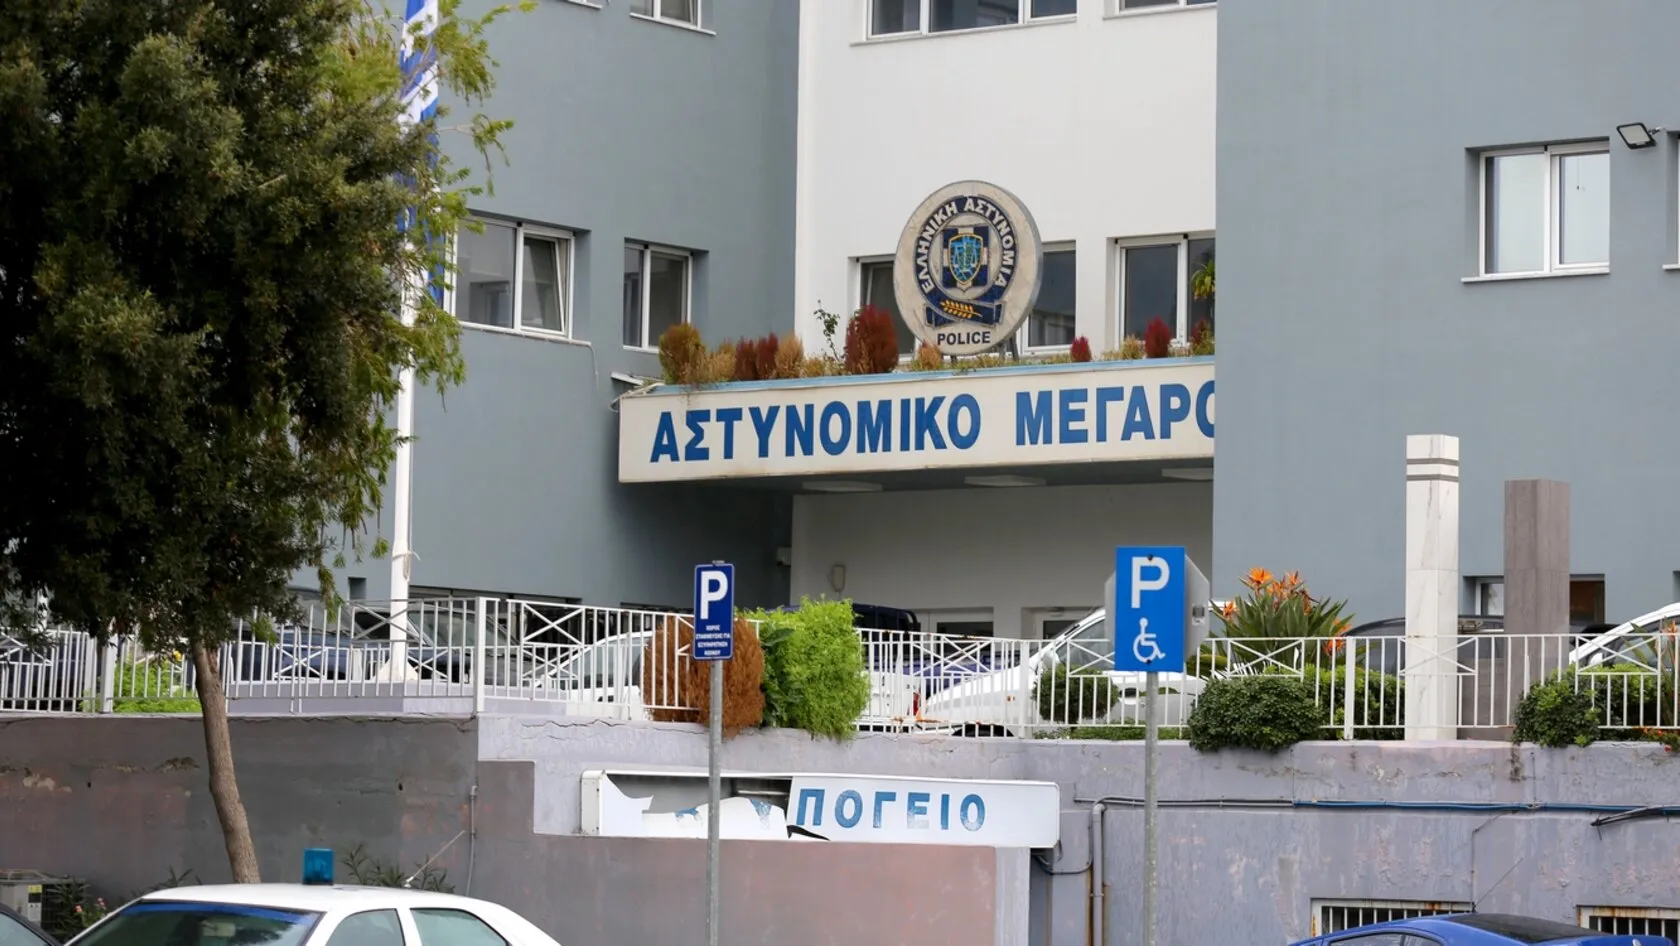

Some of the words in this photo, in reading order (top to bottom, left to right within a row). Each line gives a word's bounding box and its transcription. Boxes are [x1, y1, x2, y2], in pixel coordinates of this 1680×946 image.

[917, 201, 959, 294] ΕΛΛΗΝΙΚΗ
[963, 198, 1015, 287] ΑΣΤΥΝΟΜΙΑ
[937, 331, 991, 346] POLICE
[650, 393, 981, 463] ΑΣΤΥΝΟΜΙΚΟ
[700, 570, 728, 620] P
[1131, 556, 1170, 609] P
